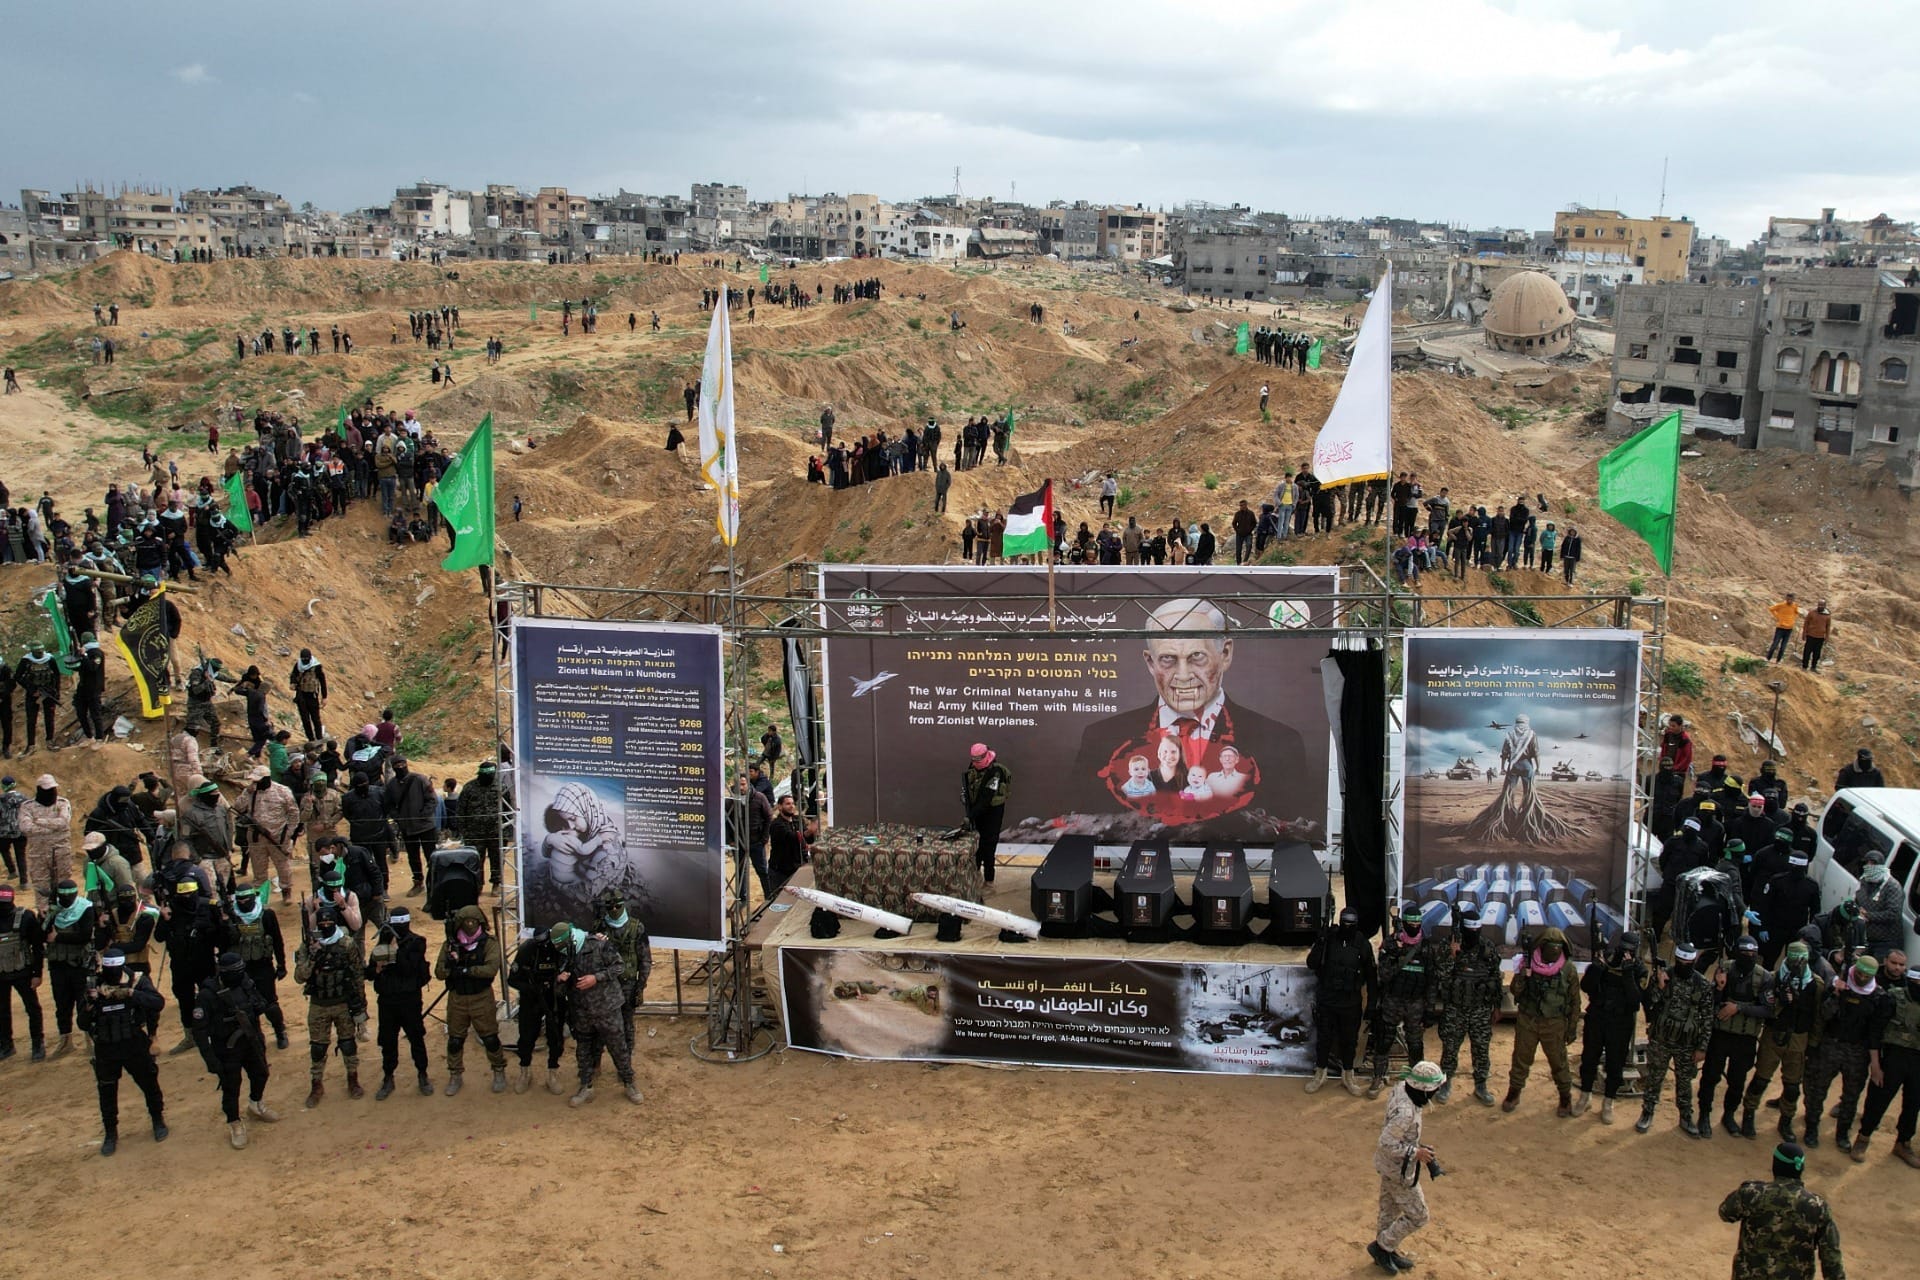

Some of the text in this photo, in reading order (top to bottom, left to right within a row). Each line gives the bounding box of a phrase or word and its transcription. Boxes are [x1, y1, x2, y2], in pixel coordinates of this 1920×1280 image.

[907, 651, 953, 660] נתנייהו
[958, 649, 1012, 661] המלחמה
[1054, 652, 1087, 662] אותם
[1092, 653, 1117, 662] רצח
[558, 666, 676, 679] Zionist Nazism in Numbers
[969, 667, 1118, 680] בטלי המטוסים הקרביים
[1428, 664, 1462, 678] توابيت
[1462, 664, 1479, 678] في
[1513, 665, 1541, 677] عودة
[1550, 667, 1584, 678] الحرب
[1585, 666, 1616, 679] عودة
[908, 686, 1117, 699] The War Criminal Netanyahu & His
[909, 701, 1117, 713] Nazi Army Killed Them with Missiles
[557, 711, 586, 719] 111000
[679, 719, 702, 728] 9268
[909, 715, 1038, 727] from Zionist Warplanes.
[678, 766, 705, 775] 17881
[679, 786, 705, 796] 12316
[978, 979, 1025, 989] ننسى
[1040, 982, 1086, 993] لنغفر
[1125, 984, 1148, 995] ما
[977, 994, 1148, 1018] وكان الطوفان موعدنا
[1087, 1023, 1102, 1033] ולא
[1159, 1025, 1170, 1035] לא
[967, 1030, 987, 1038] Never
[989, 1031, 1016, 1040] Forgave
[1143, 1040, 1172, 1048] Promise
